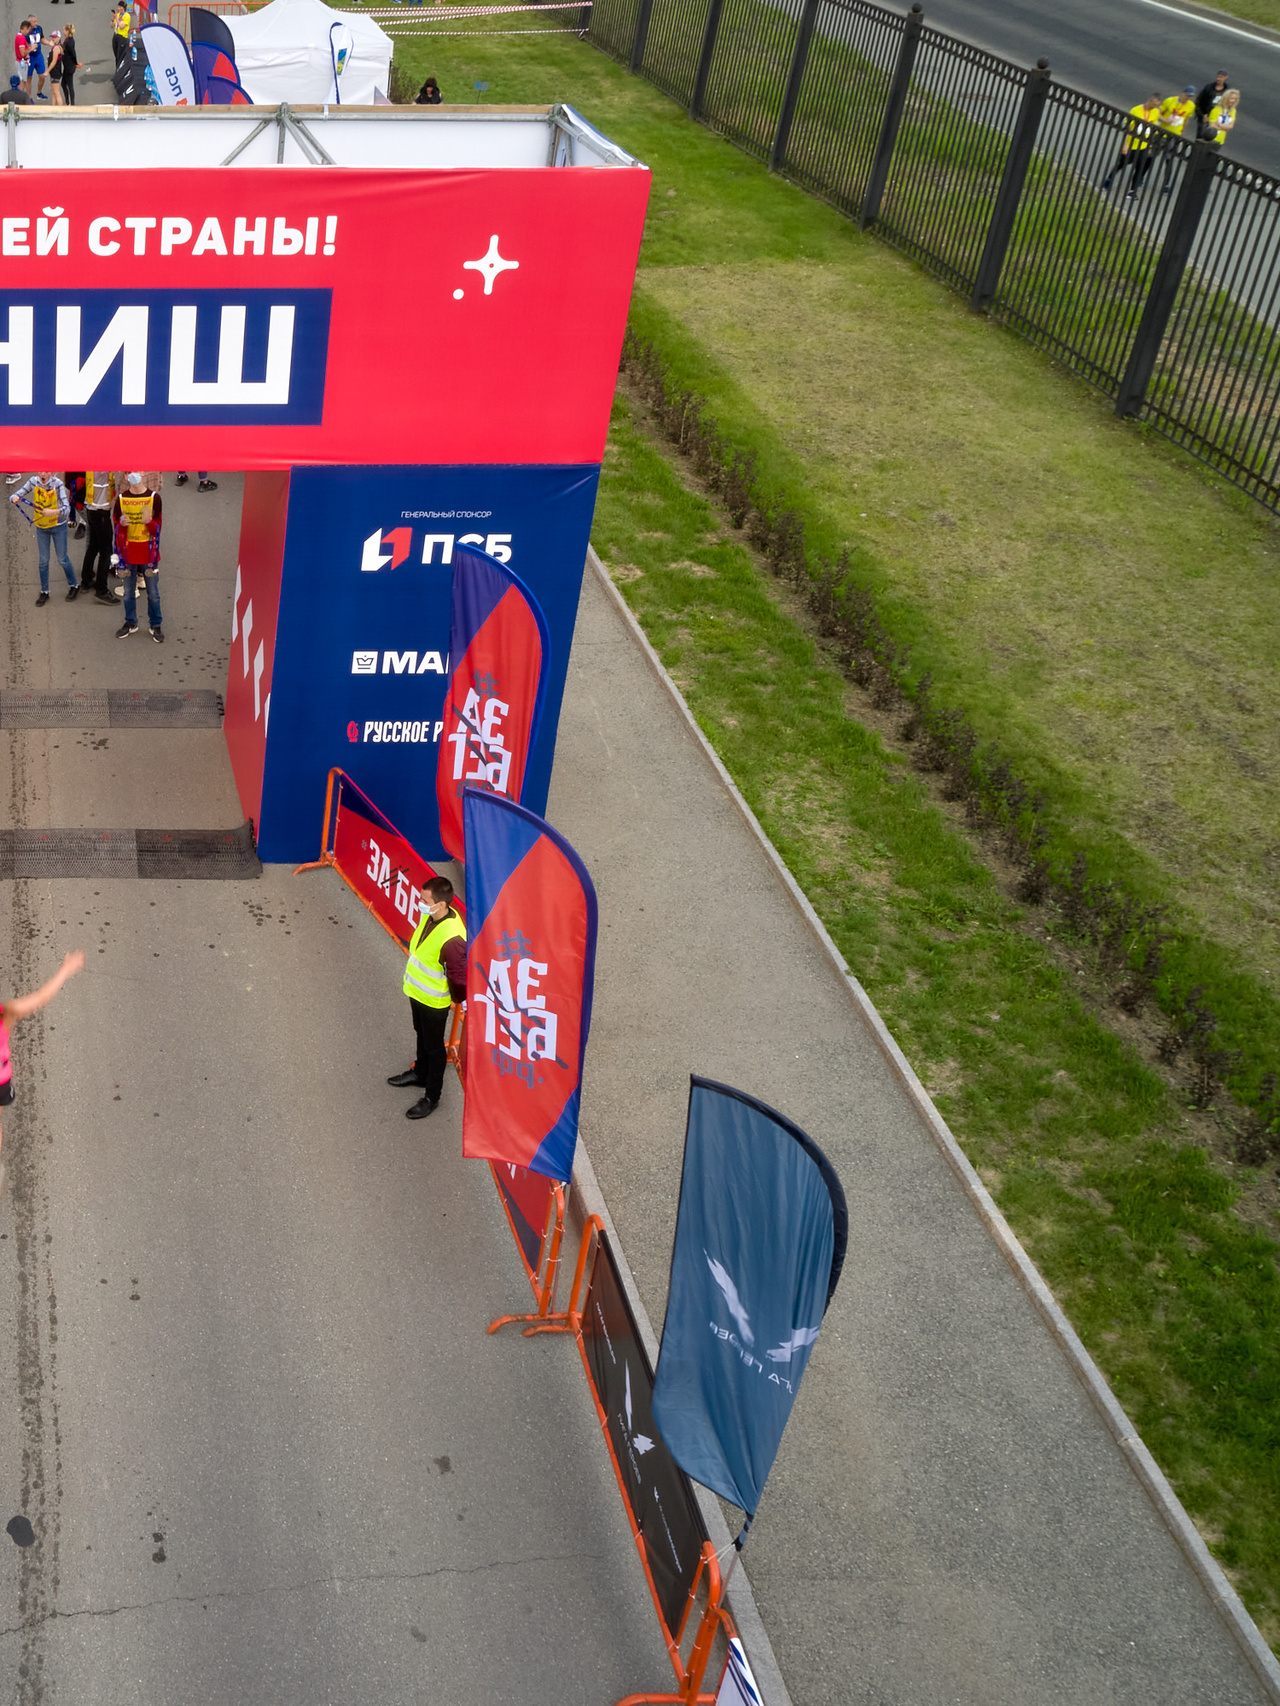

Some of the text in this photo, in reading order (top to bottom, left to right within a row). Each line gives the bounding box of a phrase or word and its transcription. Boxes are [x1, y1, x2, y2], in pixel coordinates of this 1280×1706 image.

[88, 215, 339, 257] СТРАНЫ!
[401, 510, 492, 519] ГЕНЕРАЛЬНЫЙ СПОНСОР
[382, 651, 449, 674] MA
[363, 721, 431, 743] РУССКОЕ
